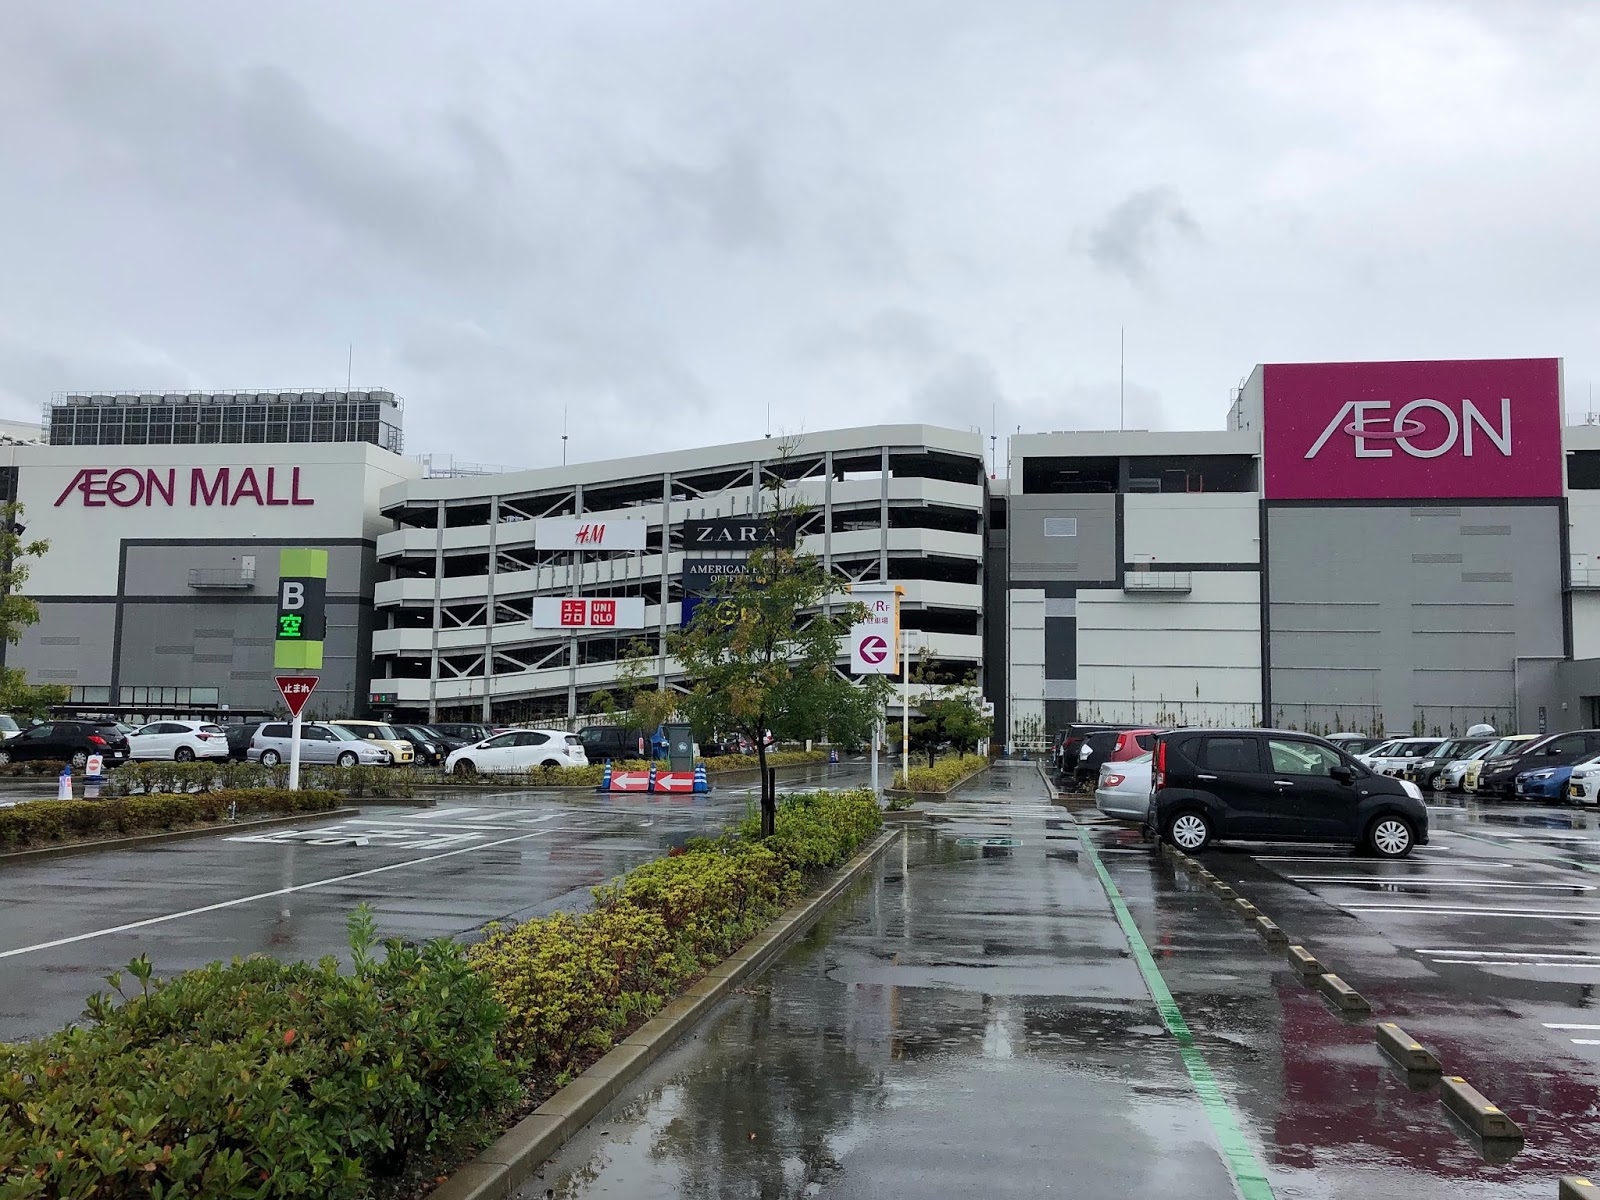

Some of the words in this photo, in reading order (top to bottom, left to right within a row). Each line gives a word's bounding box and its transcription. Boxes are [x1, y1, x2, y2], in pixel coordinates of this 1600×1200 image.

[190, 467, 315, 506] MALL
[575, 524, 606, 544] H&M
[696, 526, 782, 542] ZARA
[689, 564, 750, 574] AMERICAN
[282, 581, 305, 610] B
[279, 614, 302, 637] 空
[283, 682, 311, 694] 止まれ
